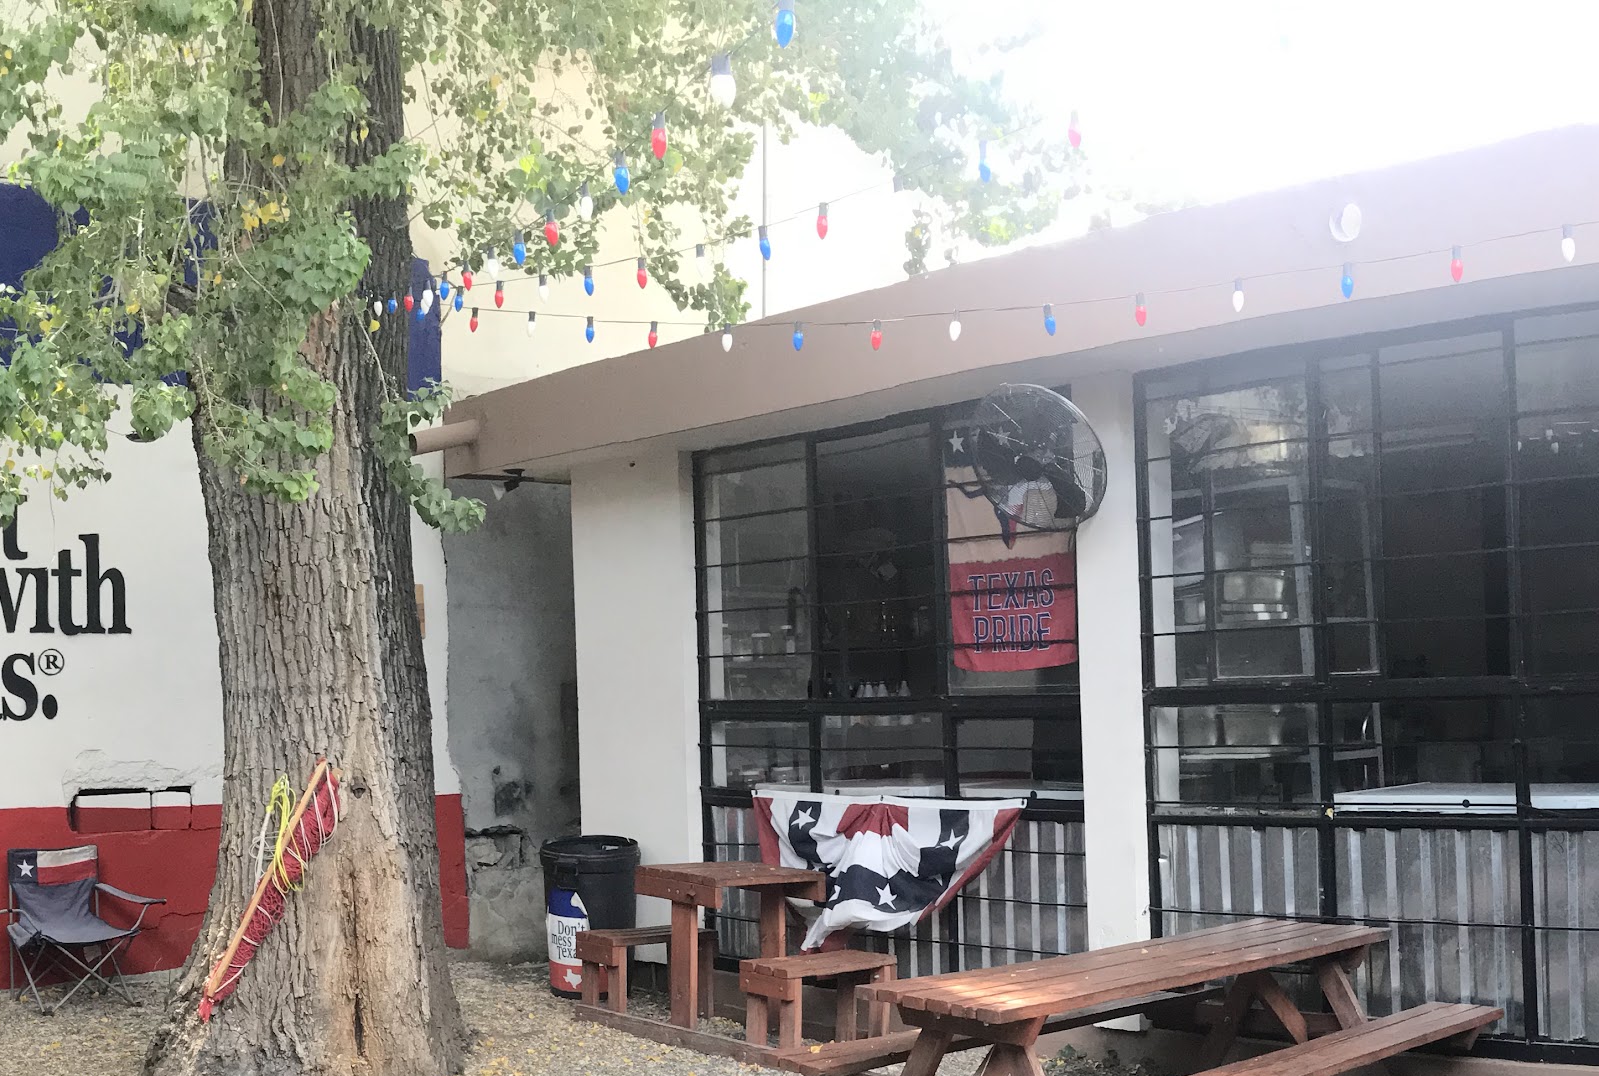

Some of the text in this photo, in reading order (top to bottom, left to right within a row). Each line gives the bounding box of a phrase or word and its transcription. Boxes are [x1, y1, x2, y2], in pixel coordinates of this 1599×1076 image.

[967, 568, 1055, 612] TEXAS
[973, 612, 1052, 654] PRIDE
[551, 933, 572, 948] mess
[556, 945, 577, 960] Texa
